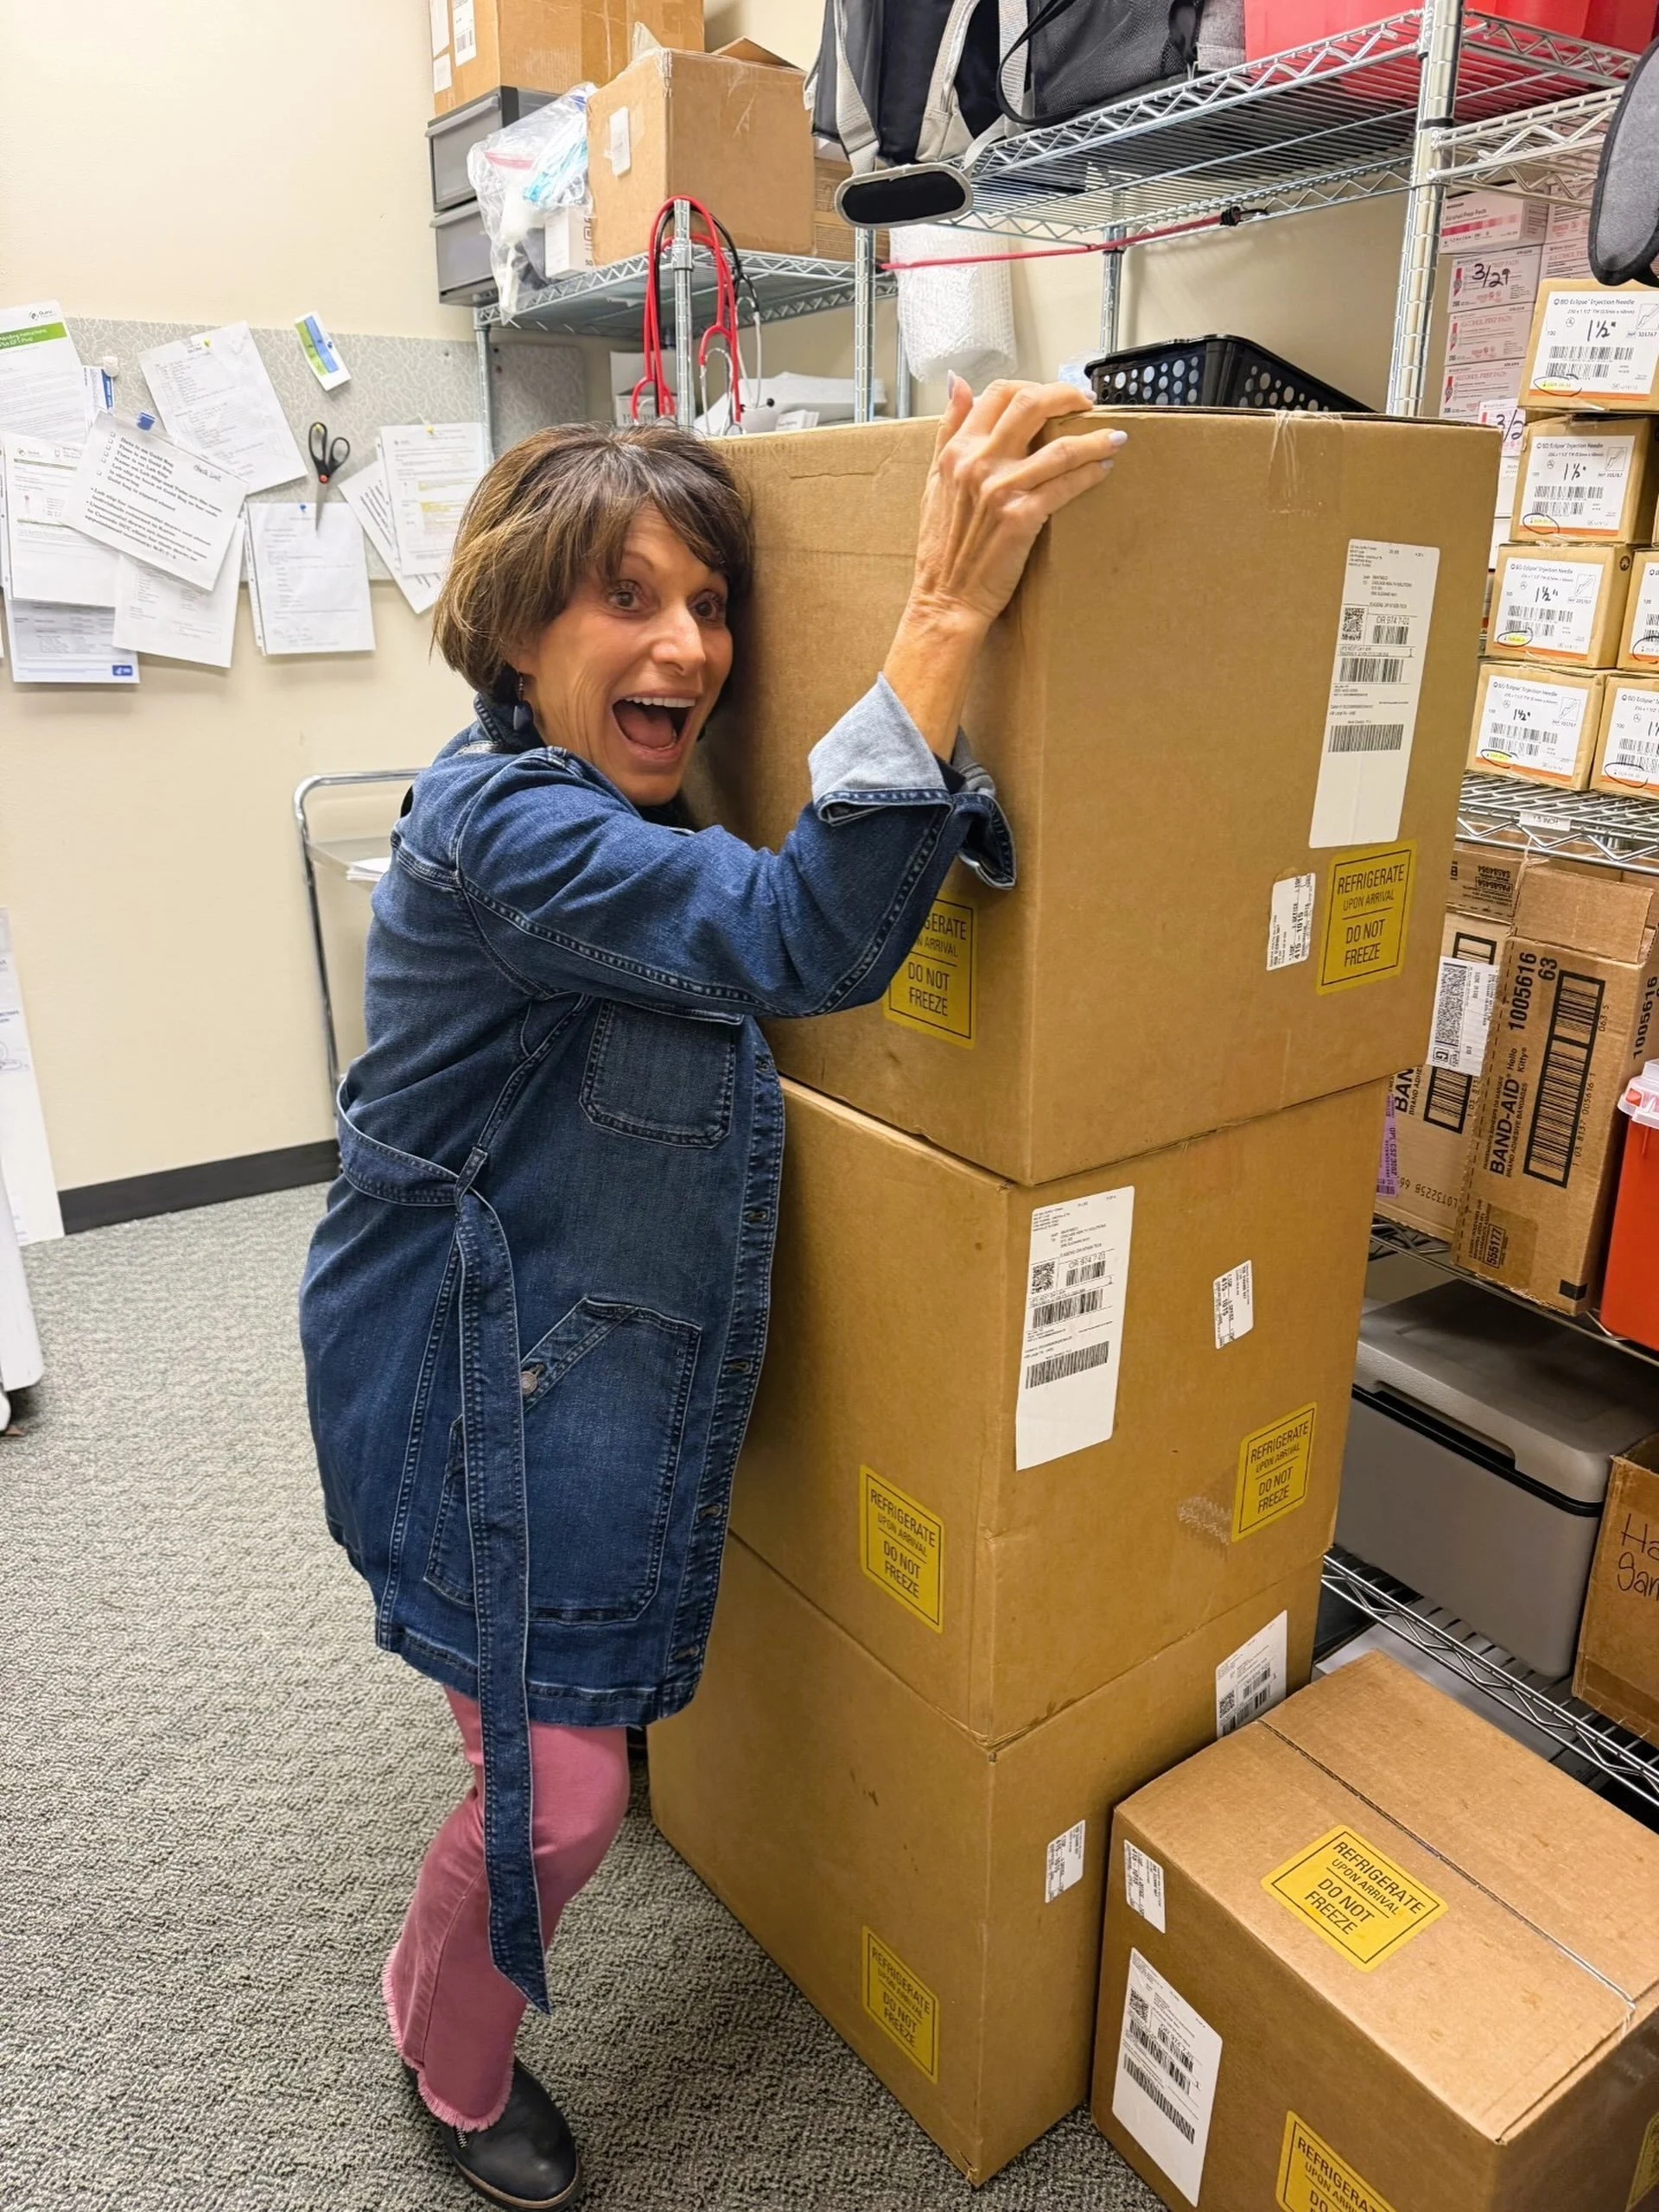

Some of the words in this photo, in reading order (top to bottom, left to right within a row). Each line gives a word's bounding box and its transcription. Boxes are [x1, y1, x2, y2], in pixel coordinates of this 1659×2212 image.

[1471, 263, 1510, 289] 3/29
[1337, 864, 1405, 895] REFRIGERATE
[1343, 895, 1363, 912] UPON
[1364, 889, 1395, 907] ARRIVAL
[924, 936, 958, 957] ARRIVAL
[1345, 925, 1361, 944] DO
[1363, 918, 1386, 939] NOT
[1344, 943, 1382, 968] FREEZE
[1538, 957, 1558, 982] 63
[908, 962, 923, 982] DO
[926, 967, 950, 992] NOT
[1508, 952, 1537, 1031] 1005616
[909, 987, 948, 1017] FREEZE
[1633, 976, 1657, 1060] 1005616
[1599, 1014, 1609, 1033] 063
[1507, 1047, 1518, 1071] Hello
[1408, 1090, 1420, 1116] BRAND
[1574, 1146, 1582, 1158] 03
[1582, 1082, 1594, 1115] 005616
[1505, 1154, 1515, 1178] BRAND
[1510, 1120, 1522, 1154] ADHESIVE
[1516, 1082, 1528, 1120] BANDAGES
[1487, 1227, 1503, 1265] 555177
[1250, 1421, 1309, 1464] REFRIGERATE
[1255, 1454, 1274, 1473] UPON
[1274, 1444, 1300, 1464] ARRIVAL
[1257, 1484, 1289, 1515] FREEZE
[1259, 1477, 1272, 1496] DO
[1273, 1466, 1293, 1490] NOT
[870, 1489, 936, 1548] REFRIGERATE
[878, 1512, 896, 1534] UPON
[898, 1529, 928, 1557] ARRIVAL
[884, 1541, 897, 1561] DO
[899, 1552, 921, 1580] NOT
[885, 1560, 919, 1599] FREEZE
[1332, 1841, 1426, 1915] REFRIGERATE
[1332, 1859, 1360, 1886] UPON
[1359, 1881, 1400, 1916] ARRIVAL
[1304, 1891, 1358, 1936] FREEZE
[1318, 1878, 1343, 1898] DO
[1338, 1895, 1376, 1923] NOT
[871, 1947, 931, 2014] REFRIGERATE
[883, 1992, 895, 2012] DO
[898, 2005, 918, 2033] NOT
[884, 2008, 917, 2048] FREEZE
[1298, 2137, 1377, 2212] REFRIGERA
[1305, 2162, 1332, 2192] UPON
[1310, 2190, 1329, 2212] DO
